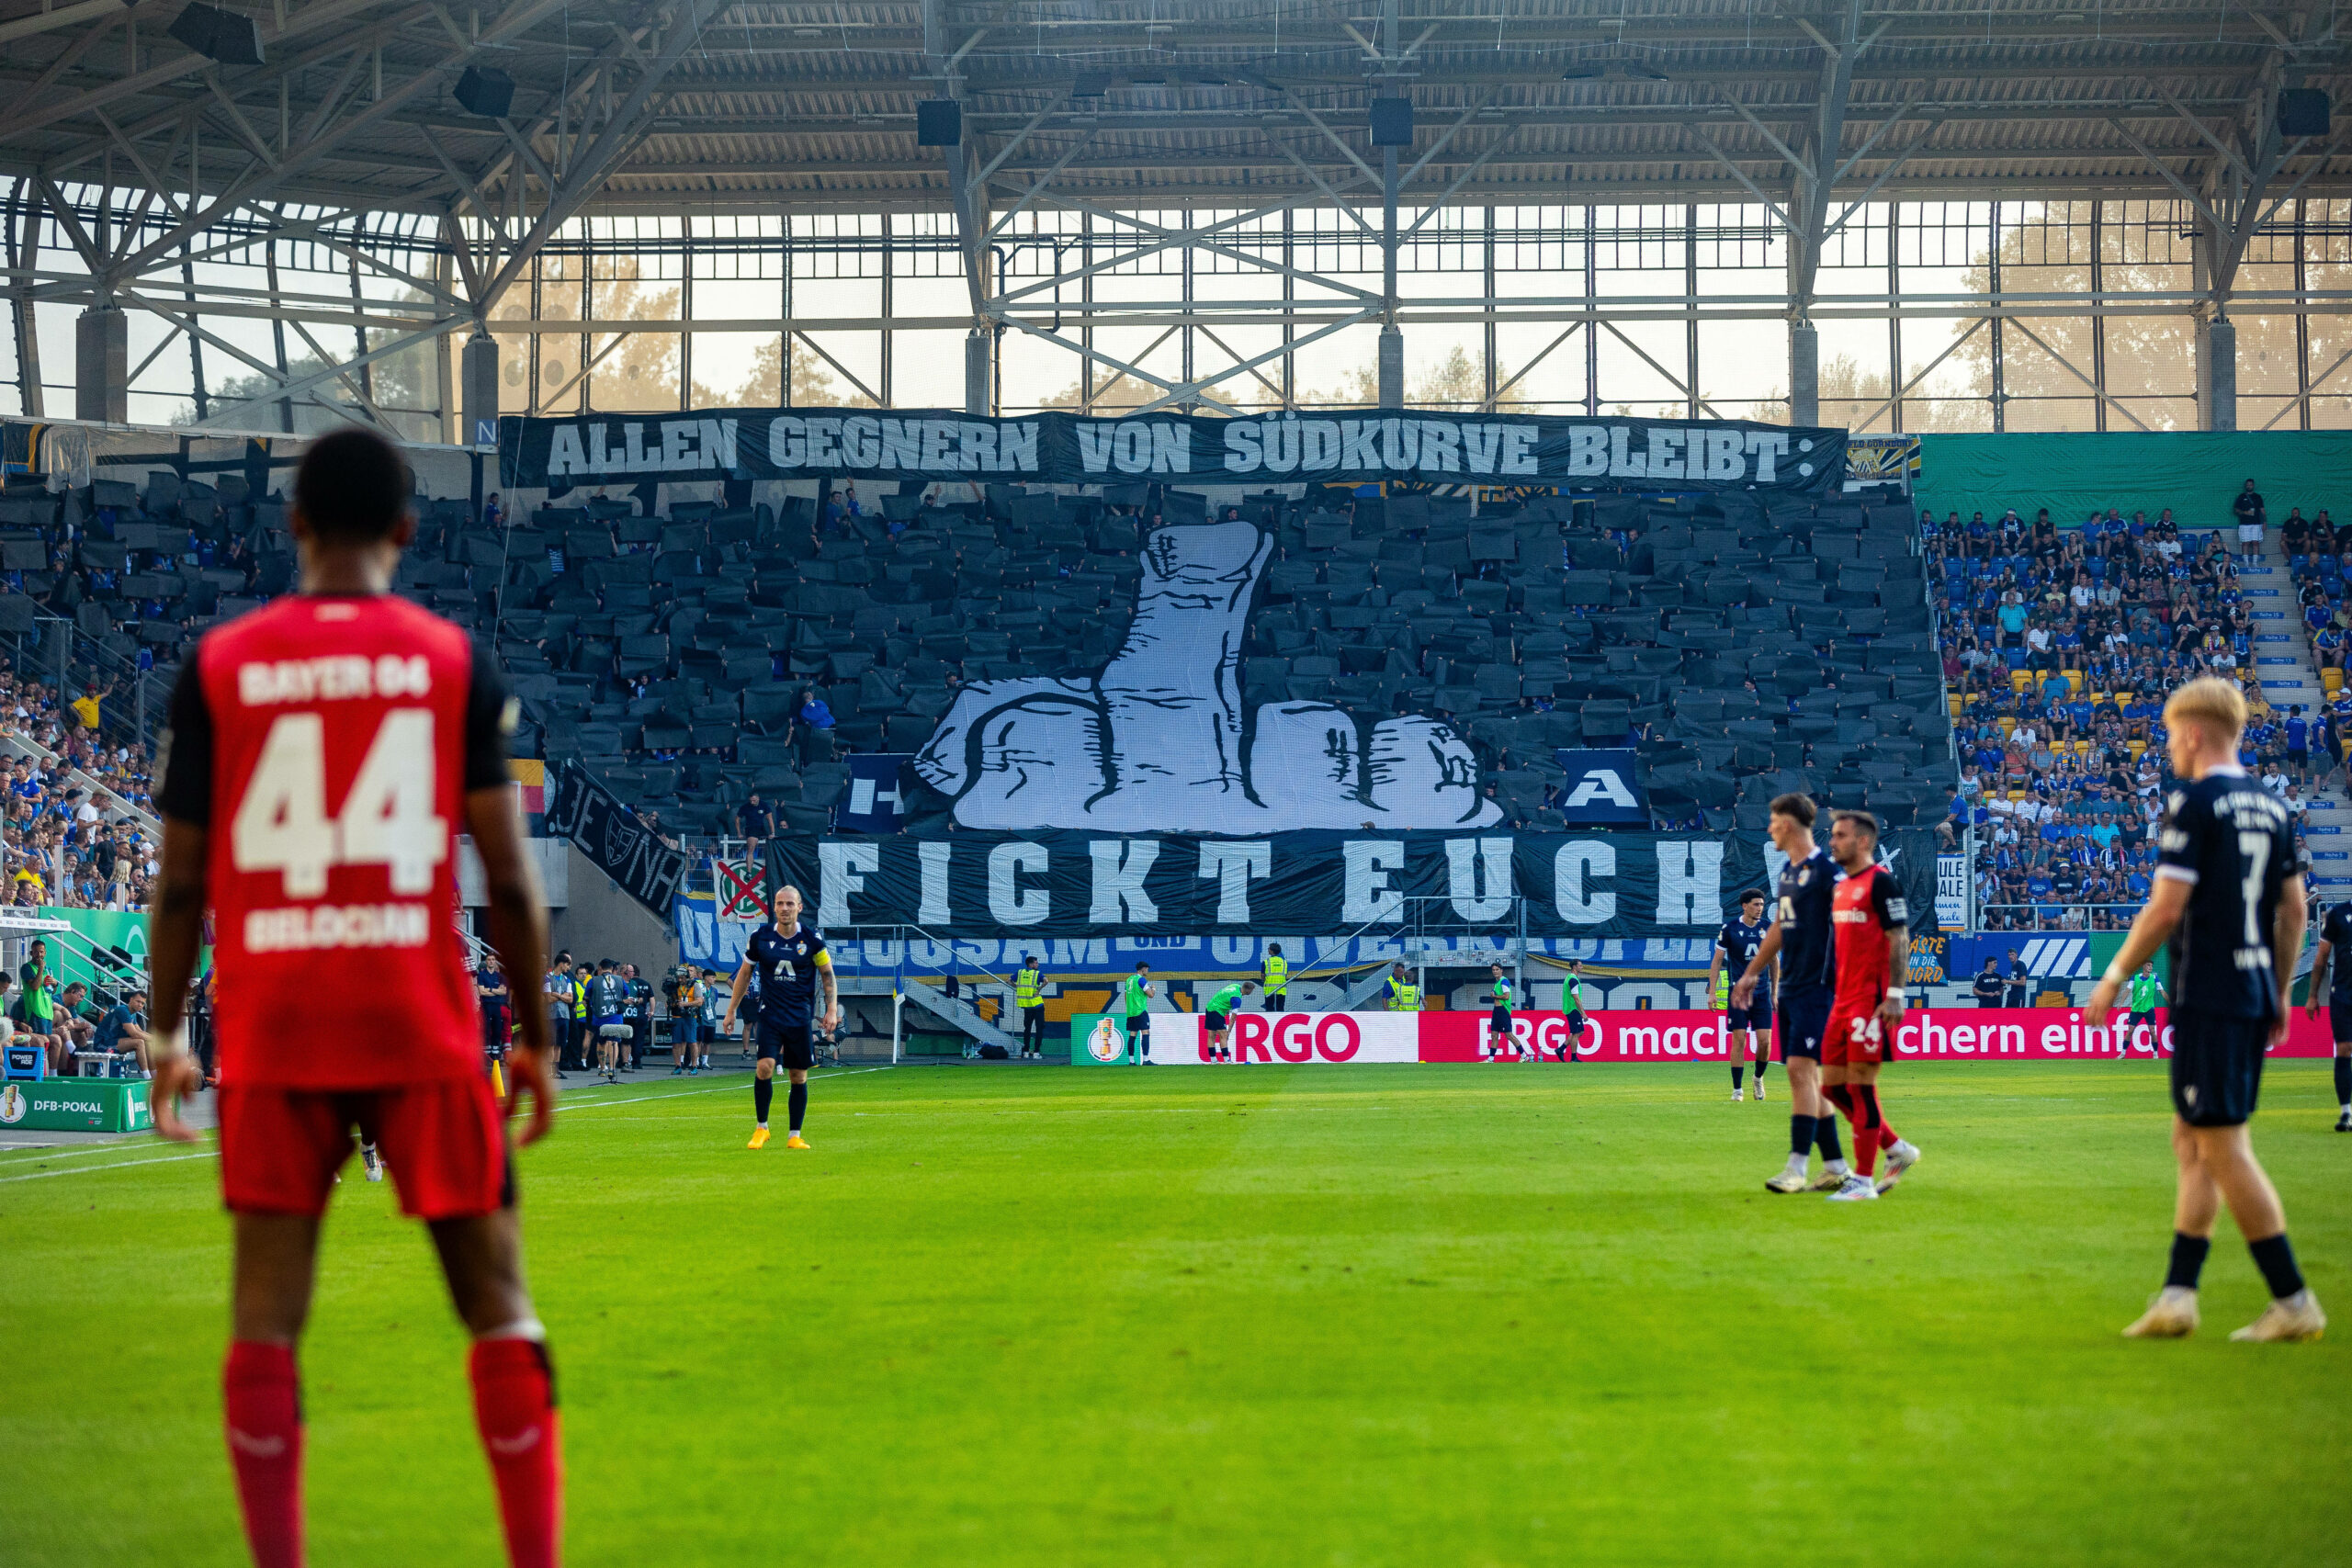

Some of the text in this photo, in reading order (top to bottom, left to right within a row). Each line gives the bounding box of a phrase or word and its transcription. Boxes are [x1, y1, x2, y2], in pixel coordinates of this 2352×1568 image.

[479, 422, 496, 442] N
[548, 410, 1813, 483] ALLEN GEGNERN VON SÜDKURVE BLEIBT:
[232, 711, 448, 899] 44
[817, 840, 1272, 927] FICKT
[2238, 831, 2272, 945] 7
[1909, 933, 1946, 954] ÄSTE
[1922, 955, 1938, 967] DIE
[1479, 1018, 1603, 1056] ERGO
[1850, 1017, 1881, 1043] 24
[34, 1100, 103, 1113] DFB-POKAL
